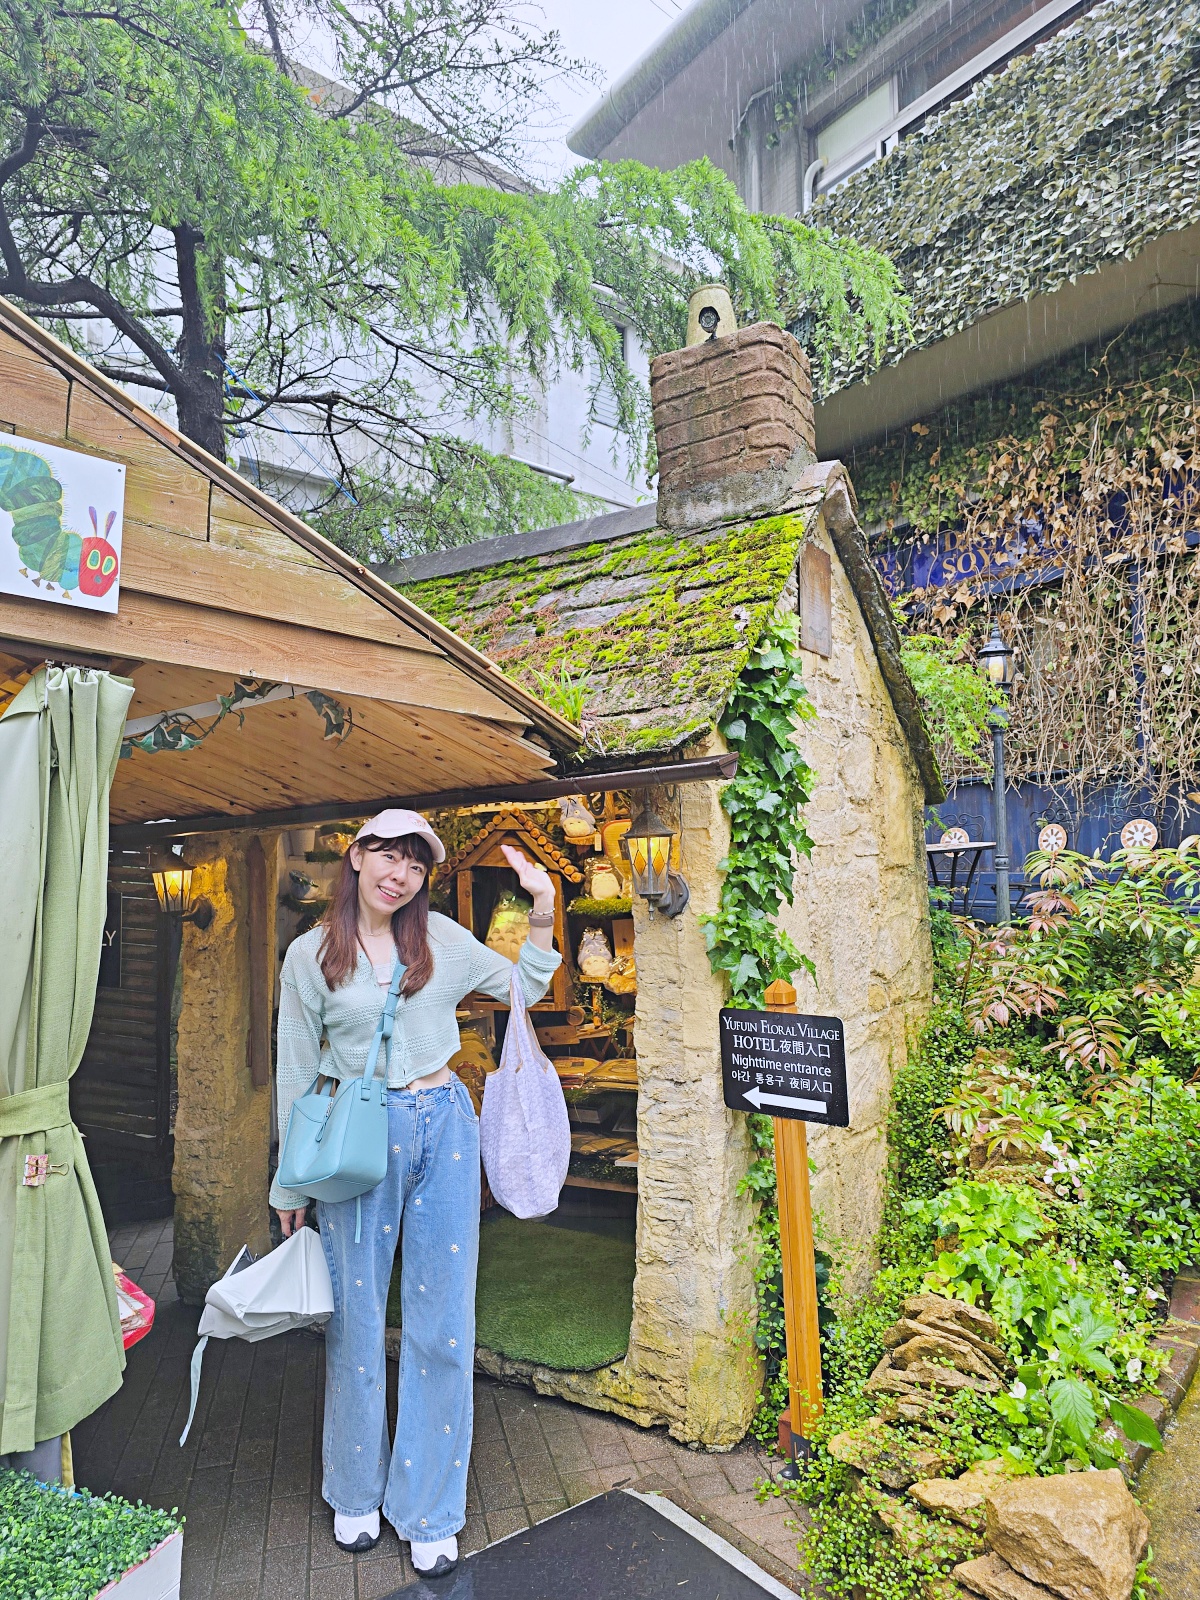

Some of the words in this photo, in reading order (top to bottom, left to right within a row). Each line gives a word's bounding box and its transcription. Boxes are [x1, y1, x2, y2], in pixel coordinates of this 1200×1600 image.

[760, 1020, 798, 1037] FLORAL
[796, 1023, 841, 1041] VILLAGE
[732, 1053, 782, 1070] Nighttime
[784, 1062, 832, 1077] entrance
[731, 1070, 751, 1083] 야간
[789, 1077, 833, 1094] 夜间入口
